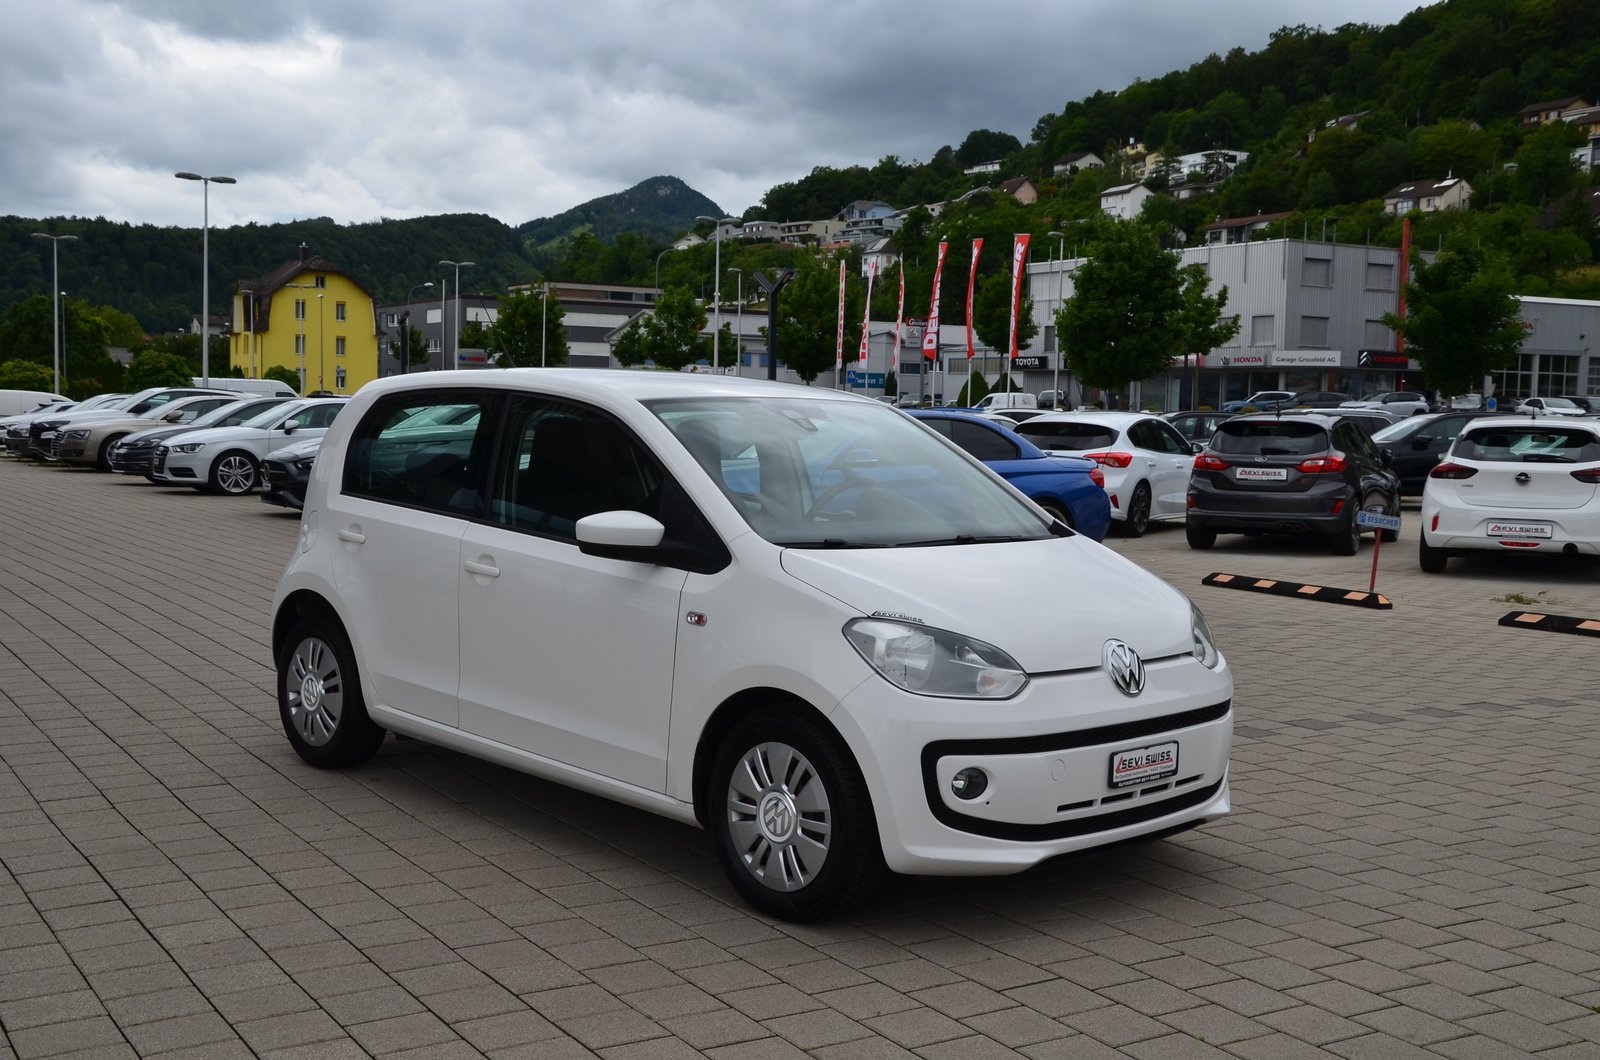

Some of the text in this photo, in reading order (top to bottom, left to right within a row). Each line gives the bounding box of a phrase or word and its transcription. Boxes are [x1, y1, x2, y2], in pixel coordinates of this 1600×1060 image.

[1015, 358, 1039, 366] TOYOTA
[1275, 356, 1297, 364] Garage
[1367, 515, 1399, 527] BESUCHER
